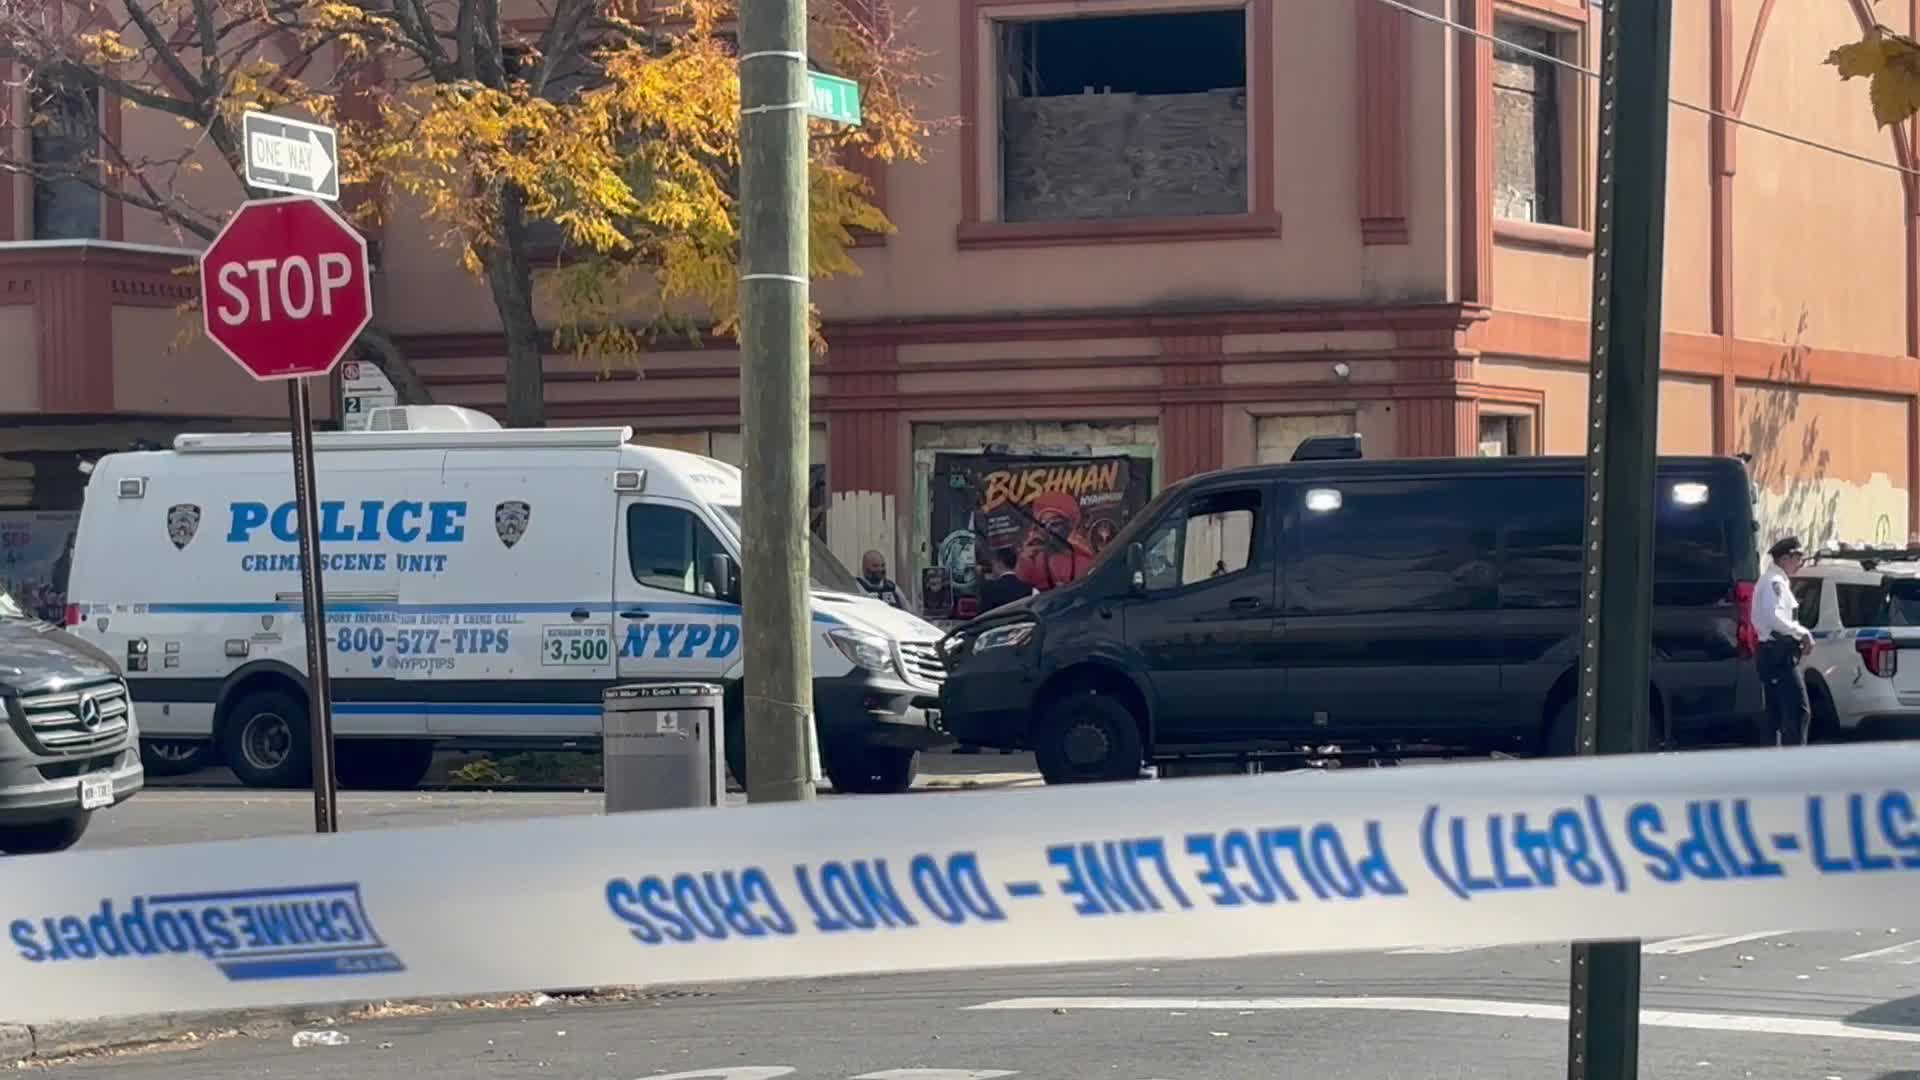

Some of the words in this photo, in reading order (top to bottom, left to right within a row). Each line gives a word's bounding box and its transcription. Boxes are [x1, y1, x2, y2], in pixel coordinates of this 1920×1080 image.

[256, 137, 283, 166] ONE
[288, 143, 312, 172] WAY
[217, 252, 353, 326] STOP
[347, 398, 358, 413] 2
[982, 461, 1119, 511] BUSHMAN
[227, 500, 468, 542] POLICE
[241, 554, 301, 572] CRIM
[319, 553, 387, 571] SCENE
[396, 553, 447, 572] UNIT
[596, 628, 606, 637] TO
[619, 623, 740, 658] NYPD
[386, 657, 455, 671] @NYPDTIPS
[1187, 820, 1408, 906] POLICE
[1420, 794, 1627, 900] (8477)
[796, 858, 914, 933] NOT
[912, 851, 1007, 925] DO
[1047, 836, 1193, 915] LINE
[605, 866, 797, 945] CROSS
